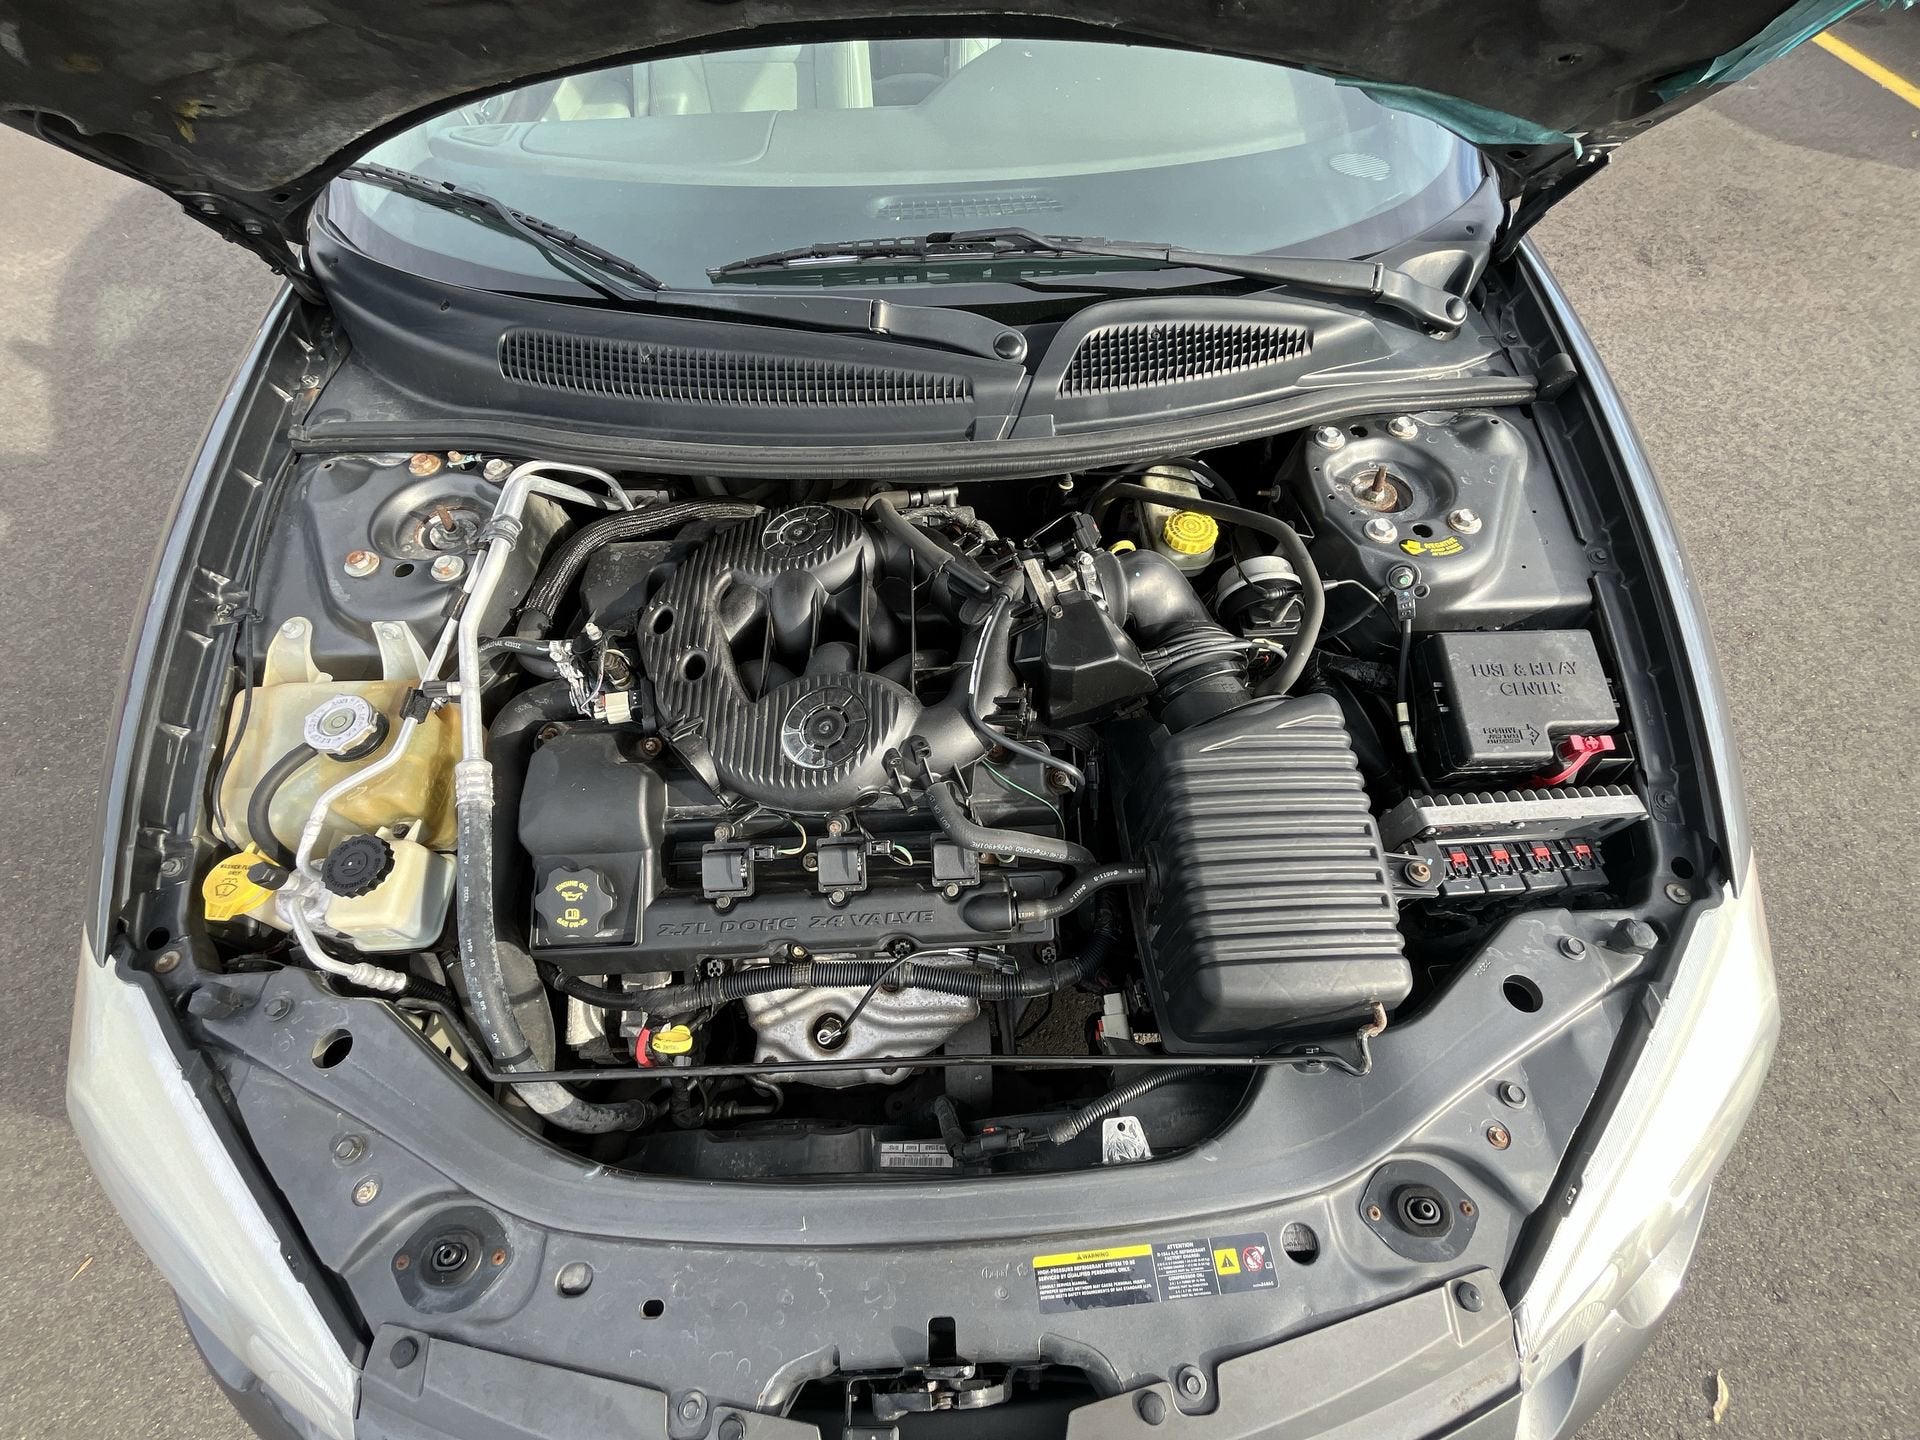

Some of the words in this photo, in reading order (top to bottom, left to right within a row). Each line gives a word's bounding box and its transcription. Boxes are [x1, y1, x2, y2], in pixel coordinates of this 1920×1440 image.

[1471, 663, 1506, 677] FUSE
[1514, 662, 1528, 677] &
[1529, 661, 1577, 676] RELAY
[1500, 681, 1563, 696] CENTER
[555, 880, 579, 892] ENGINE
[578, 882, 589, 893] OIL
[656, 922, 713, 936] 2.7L
[719, 917, 798, 933] DOHC
[808, 915, 846, 928] 24
[850, 910, 935, 928] VALVE
[1166, 1242, 1194, 1250] ATTENTION
[1082, 1251, 1110, 1260] WARNING
